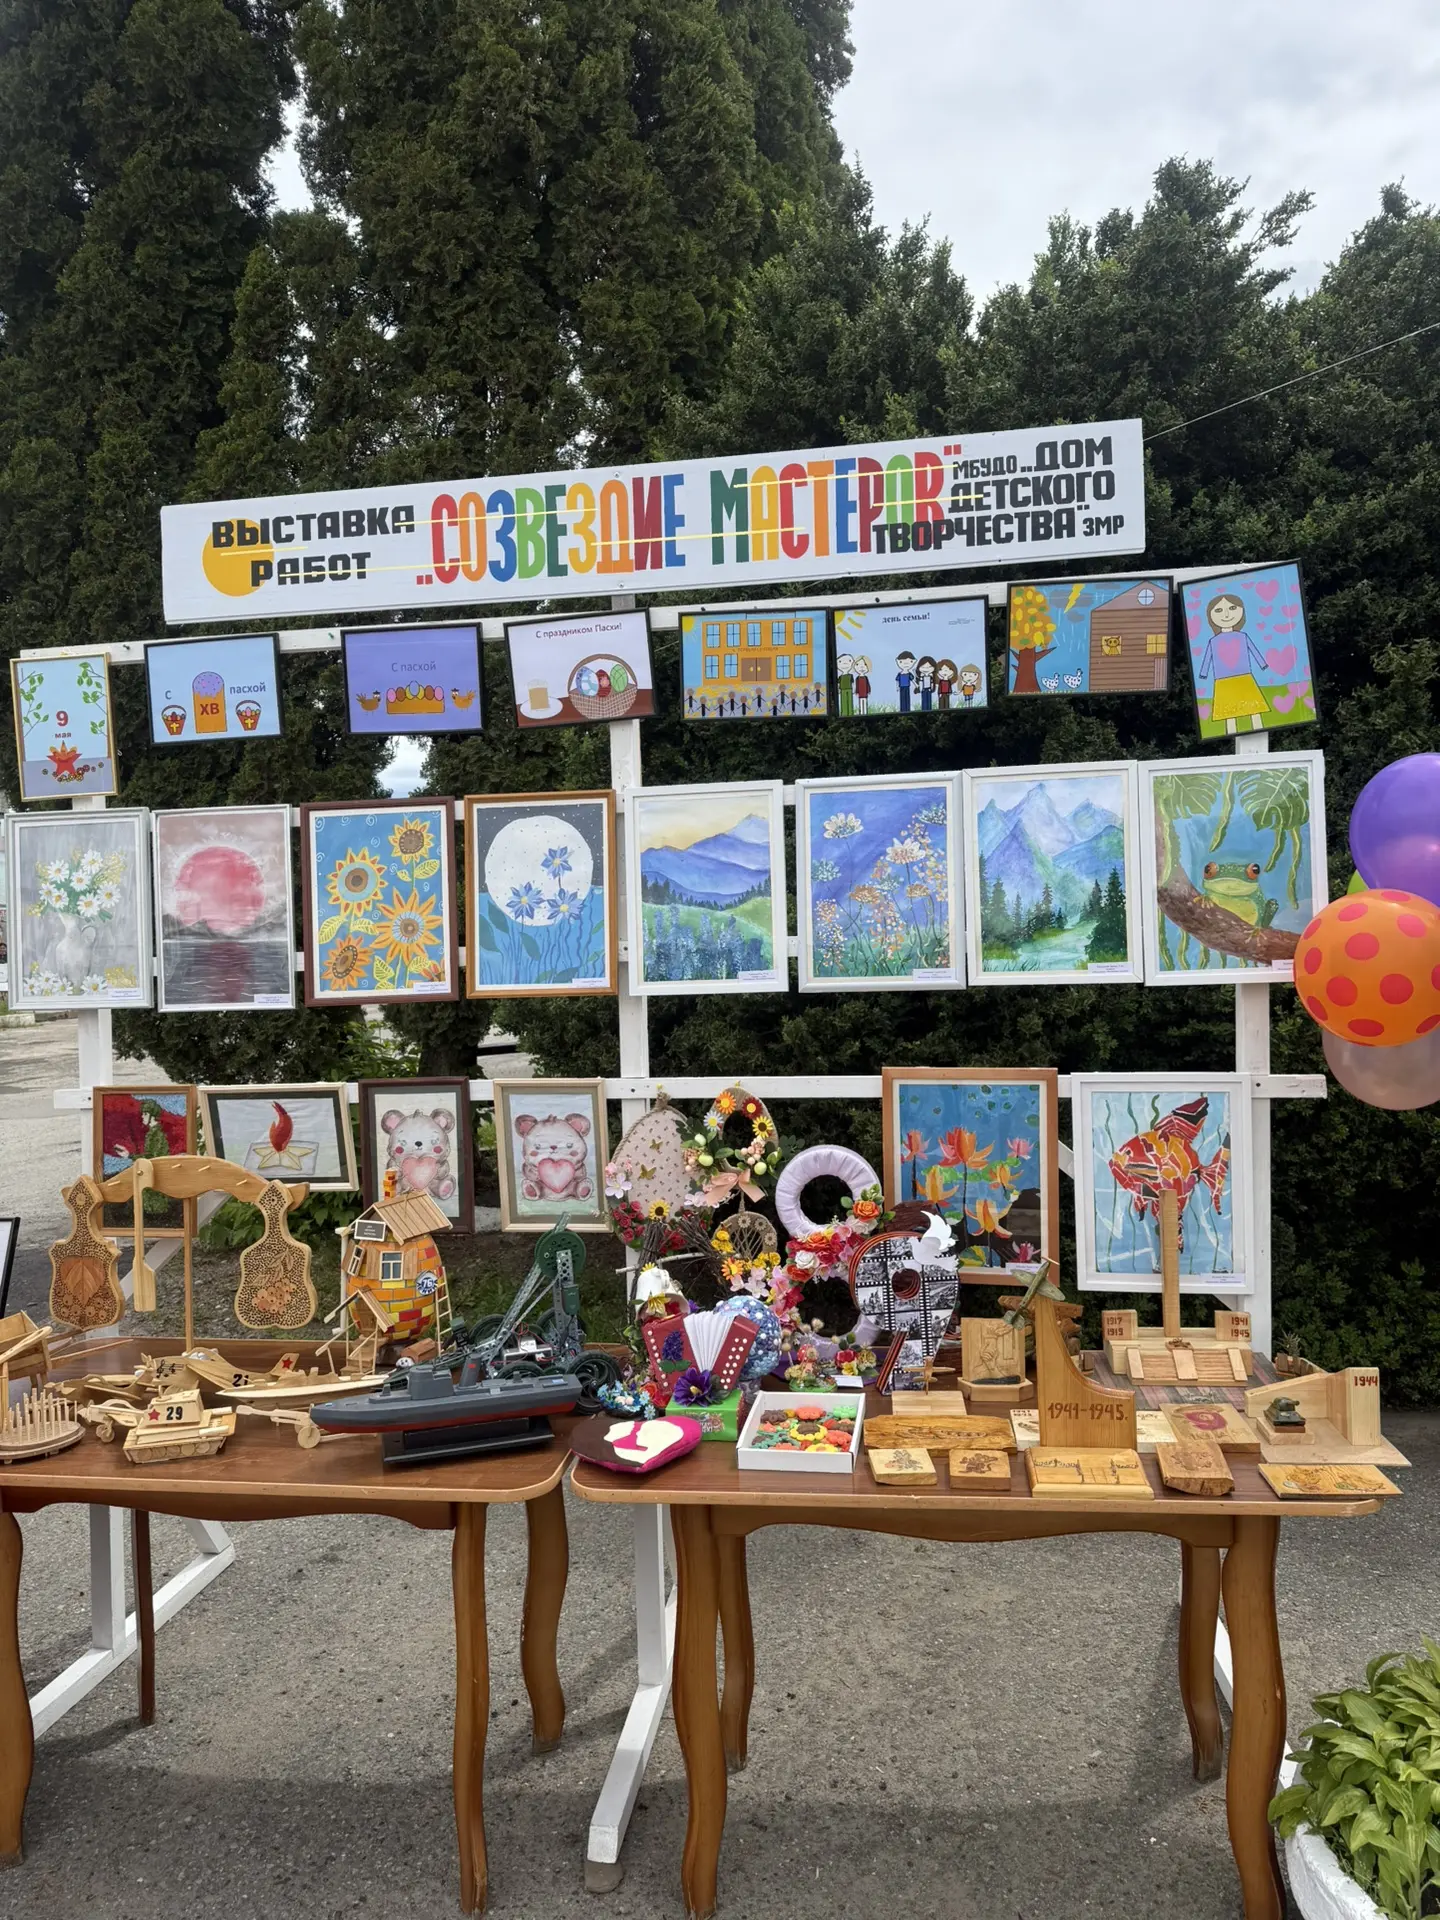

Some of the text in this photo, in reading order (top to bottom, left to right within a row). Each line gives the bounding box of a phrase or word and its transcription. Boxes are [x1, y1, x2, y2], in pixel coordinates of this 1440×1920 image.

[953, 455, 1018, 480] МБУДО
[948, 470, 1116, 513] ДЕТСКОГО
[212, 505, 415, 548] ВЫСТАВКА
[251, 552, 371, 587] РАБОТ
[882, 612, 931, 624] день семьи!
[543, 627, 593, 639] праздником
[595, 622, 623, 633] Пасхи!
[400, 660, 437, 672] пасхой
[229, 681, 266, 695] пасхой
[200, 703, 220, 716] ХВ
[56, 710, 69, 727] 9
[1106, 1316, 1123, 1325] 1917
[1231, 1316, 1248, 1326] 1941
[1230, 1328, 1250, 1338] 1945
[1353, 1375, 1379, 1387] 1944
[166, 1406, 183, 1421] 29
[1047, 1402, 1129, 1421] 1941-1945.
